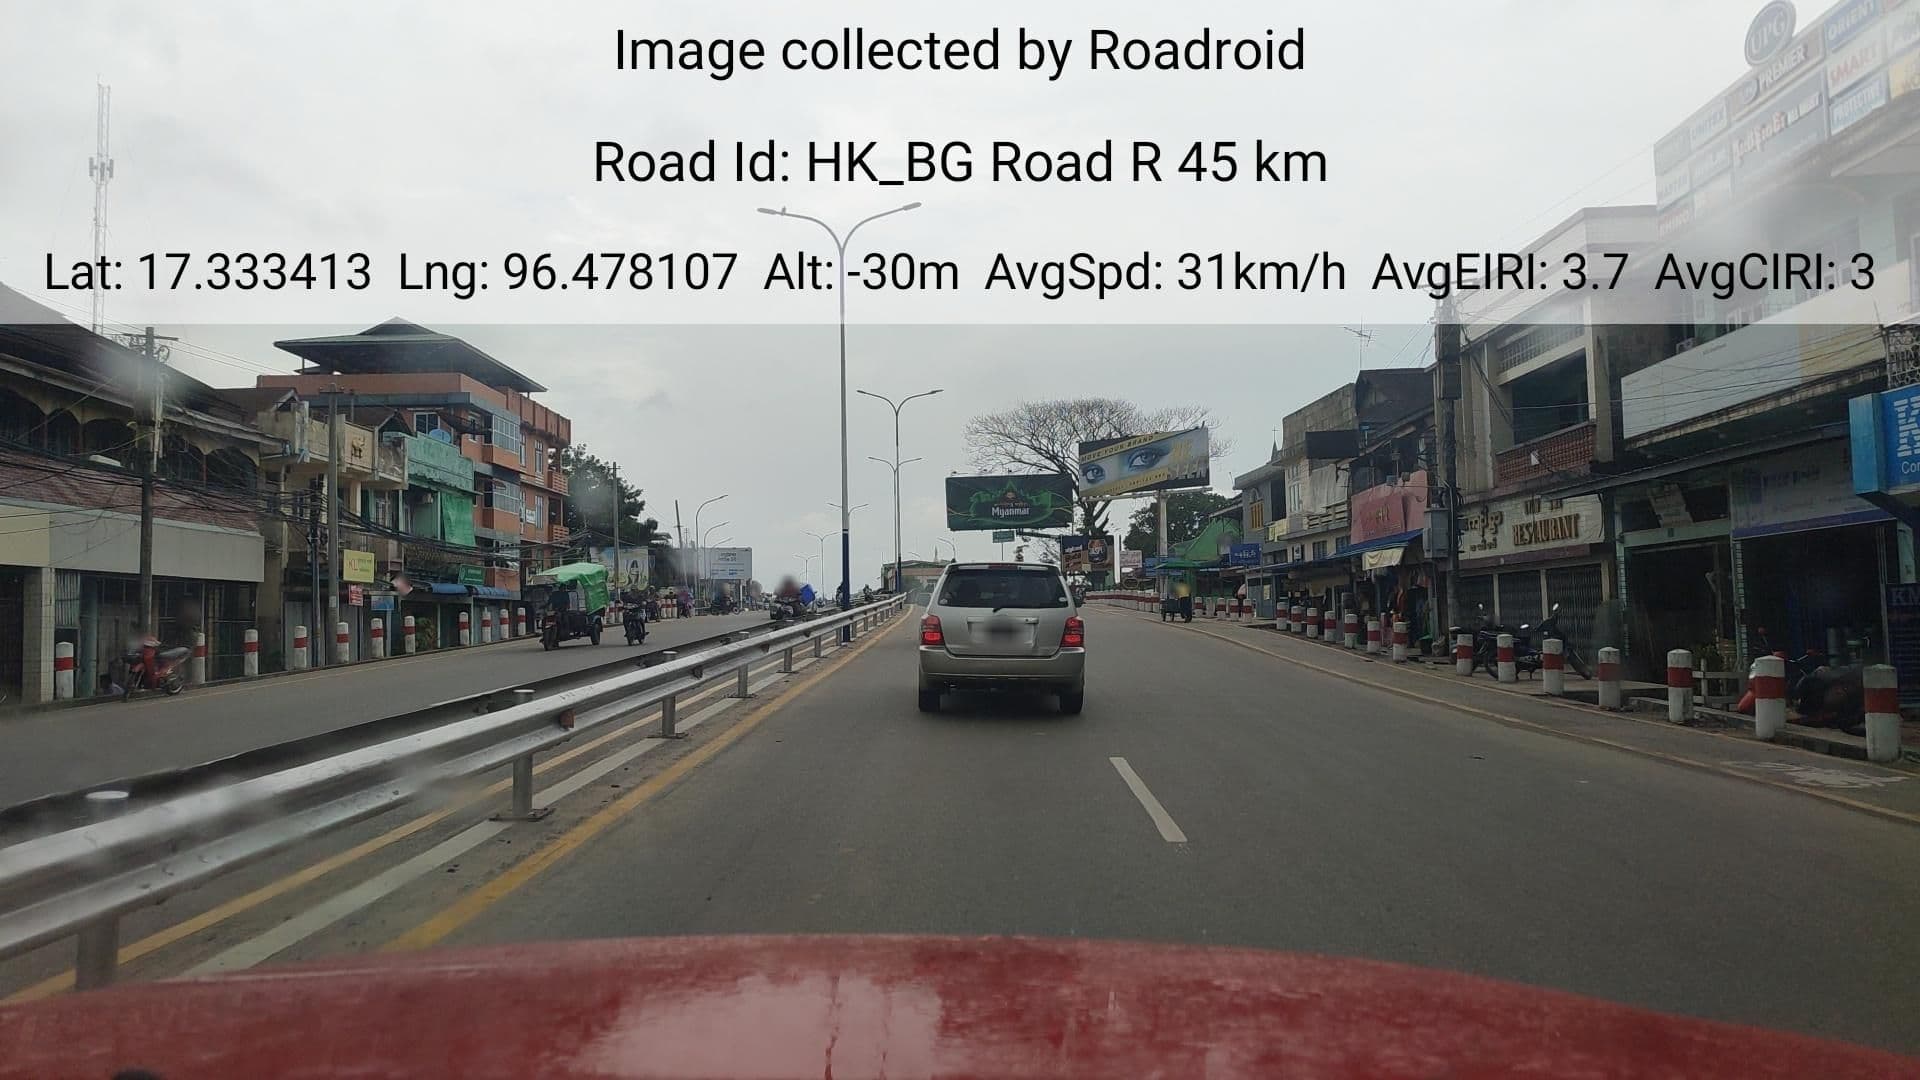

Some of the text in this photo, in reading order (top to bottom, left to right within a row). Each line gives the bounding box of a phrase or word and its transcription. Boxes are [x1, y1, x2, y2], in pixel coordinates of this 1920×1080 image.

[1758, 44, 1806, 89] PREMIER
[1104, 443, 1125, 456] YOUR
[1127, 434, 1154, 448] BRAND
[991, 506, 1030, 518] Myanmar
[1512, 513, 1580, 546] RESTAURANT
